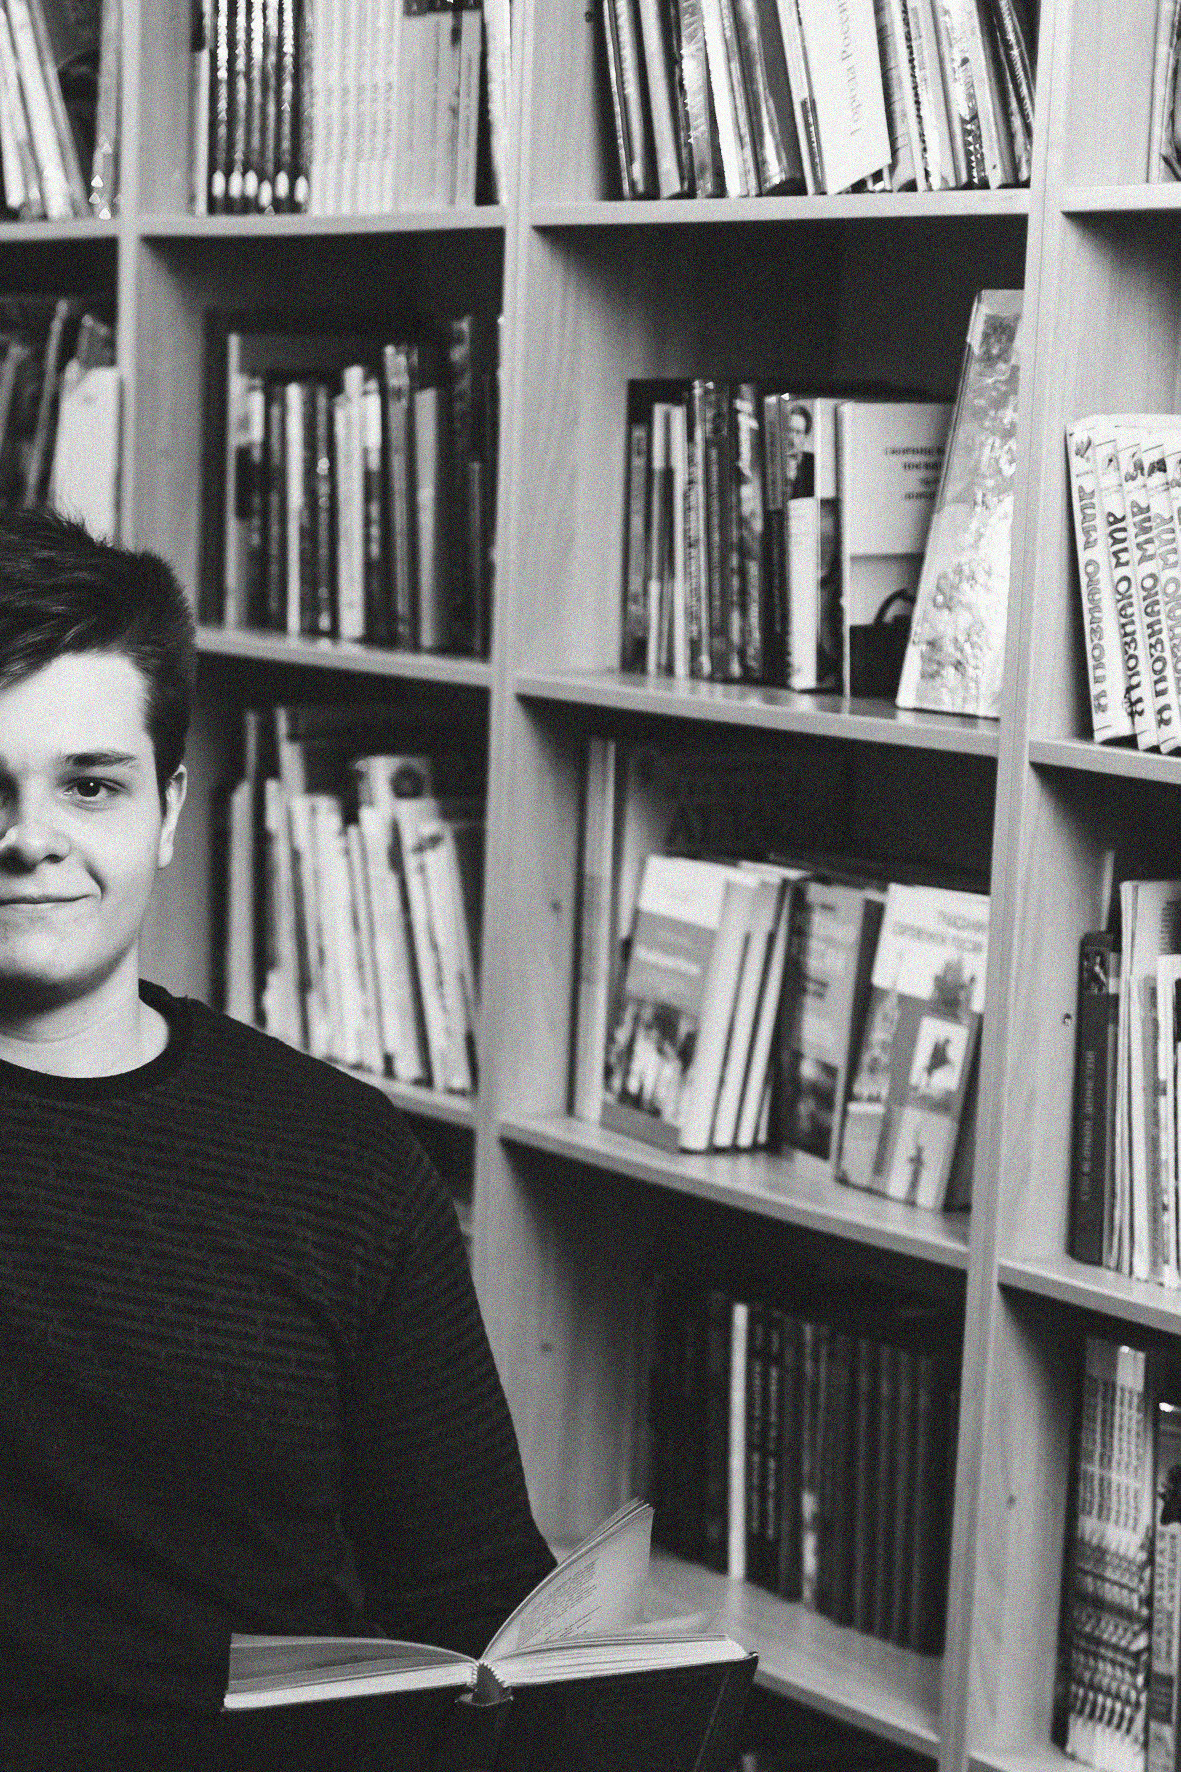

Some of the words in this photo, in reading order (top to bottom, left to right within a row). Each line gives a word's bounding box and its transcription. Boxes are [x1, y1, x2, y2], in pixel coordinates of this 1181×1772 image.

[836, 0, 854, 62] Росси
[1077, 485, 1098, 552] МИР
[1106, 510, 1130, 569] МИР
[1130, 500, 1157, 567] МИР
[1153, 512, 1176, 571] МИР
[1083, 559, 1106, 685] ПОЗНАЮ
[1115, 575, 1141, 696] ПОЗНАЮ
[1140, 573, 1168, 698] ПОЗНАЮ
[1092, 690, 1108, 715] Я
[1155, 703, 1172, 729] Я
